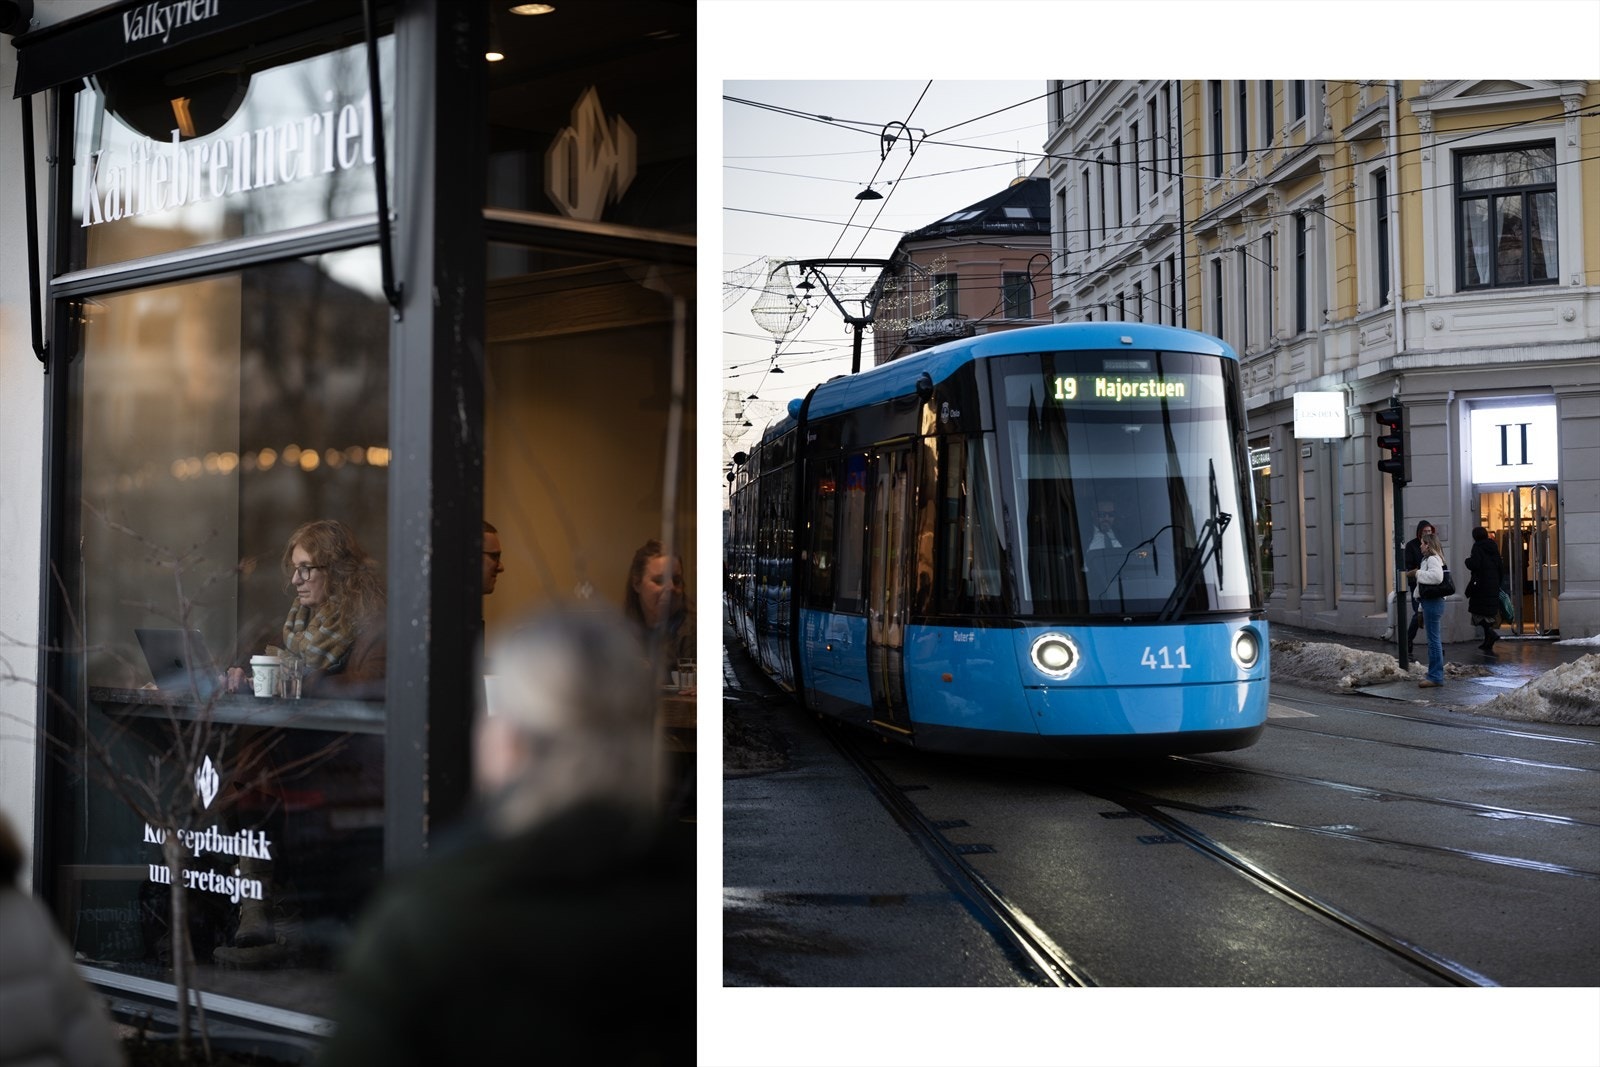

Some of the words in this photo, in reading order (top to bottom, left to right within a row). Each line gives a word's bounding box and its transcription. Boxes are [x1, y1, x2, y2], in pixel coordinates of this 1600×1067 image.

[122, 0, 219, 43] Valkyrien
[80, 90, 376, 228] Kaffebrenneriet
[1054, 377, 1077, 400] 19
[1095, 377, 1185, 402] Majorstuen
[1141, 645, 1192, 669] 411
[143, 821, 272, 861] Koseptbutikk
[148, 863, 263, 904] uneretasjen
